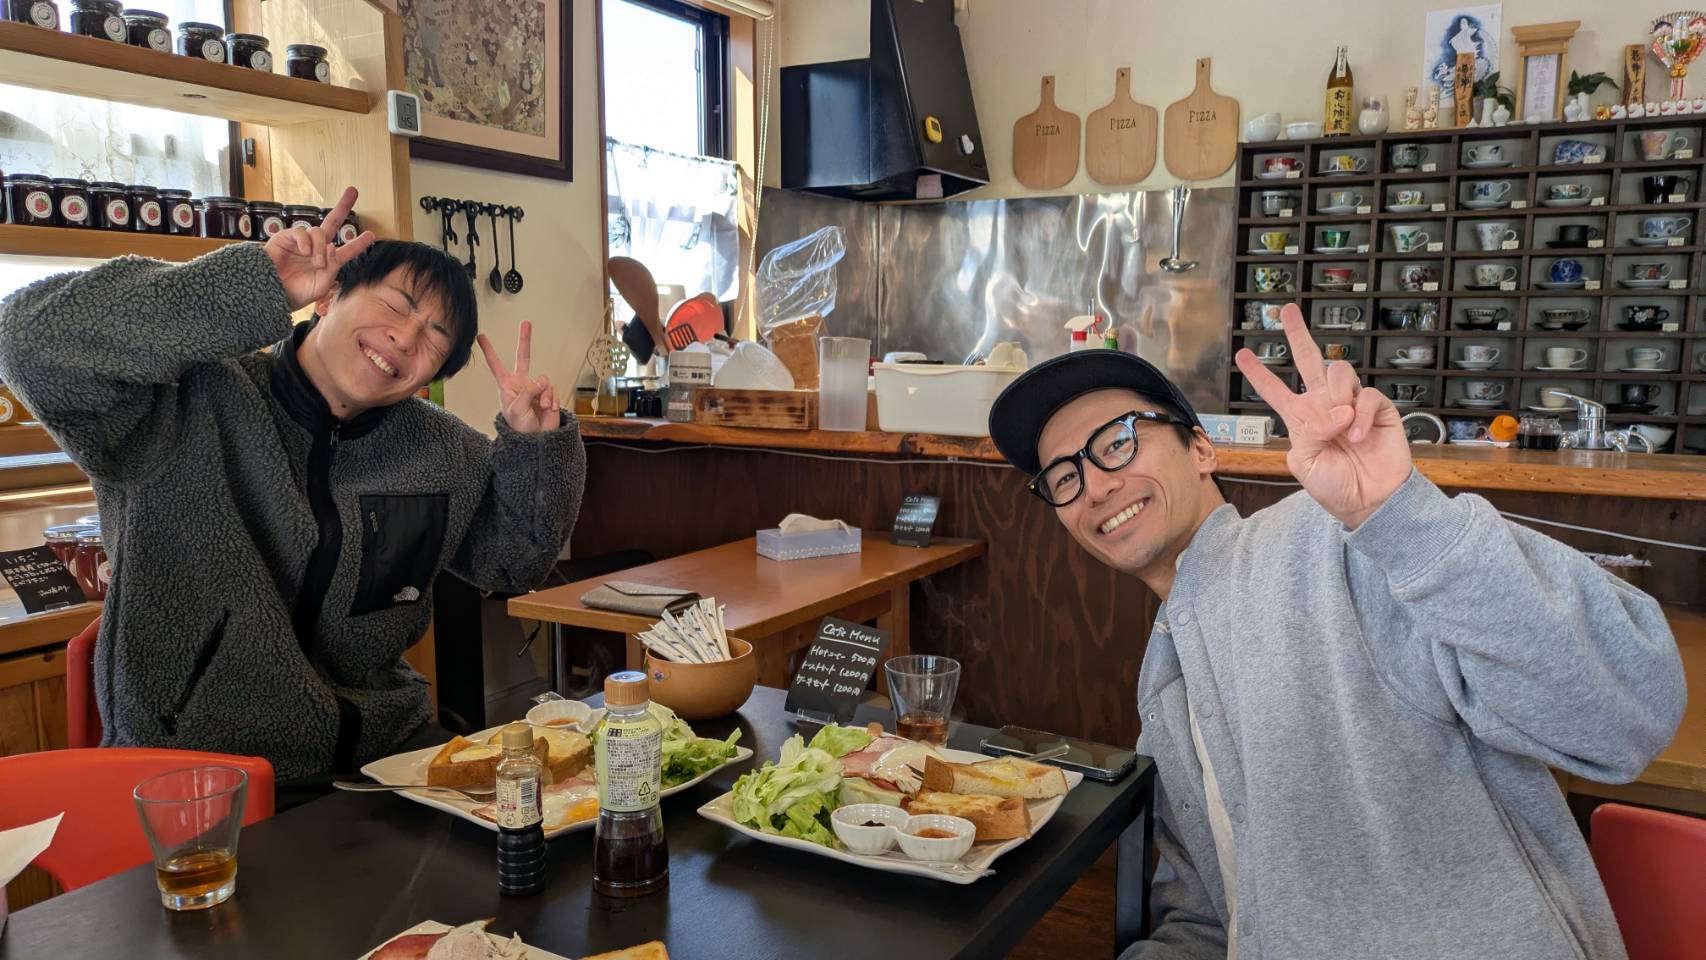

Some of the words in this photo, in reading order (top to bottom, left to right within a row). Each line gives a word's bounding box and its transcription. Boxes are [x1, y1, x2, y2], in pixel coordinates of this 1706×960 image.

[1189, 110, 1216, 123] PIZZA
[1036, 124, 1060, 136] PIZZA
[1110, 118, 1137, 130] PIZZA
[5, 551, 38, 564] いちご
[823, 624, 846, 637] Cafe
[850, 630, 880, 644] Menu
[851, 652, 876, 666] 500円
[840, 667, 868, 682] 1200円
[833, 683, 860, 696] 1200円
